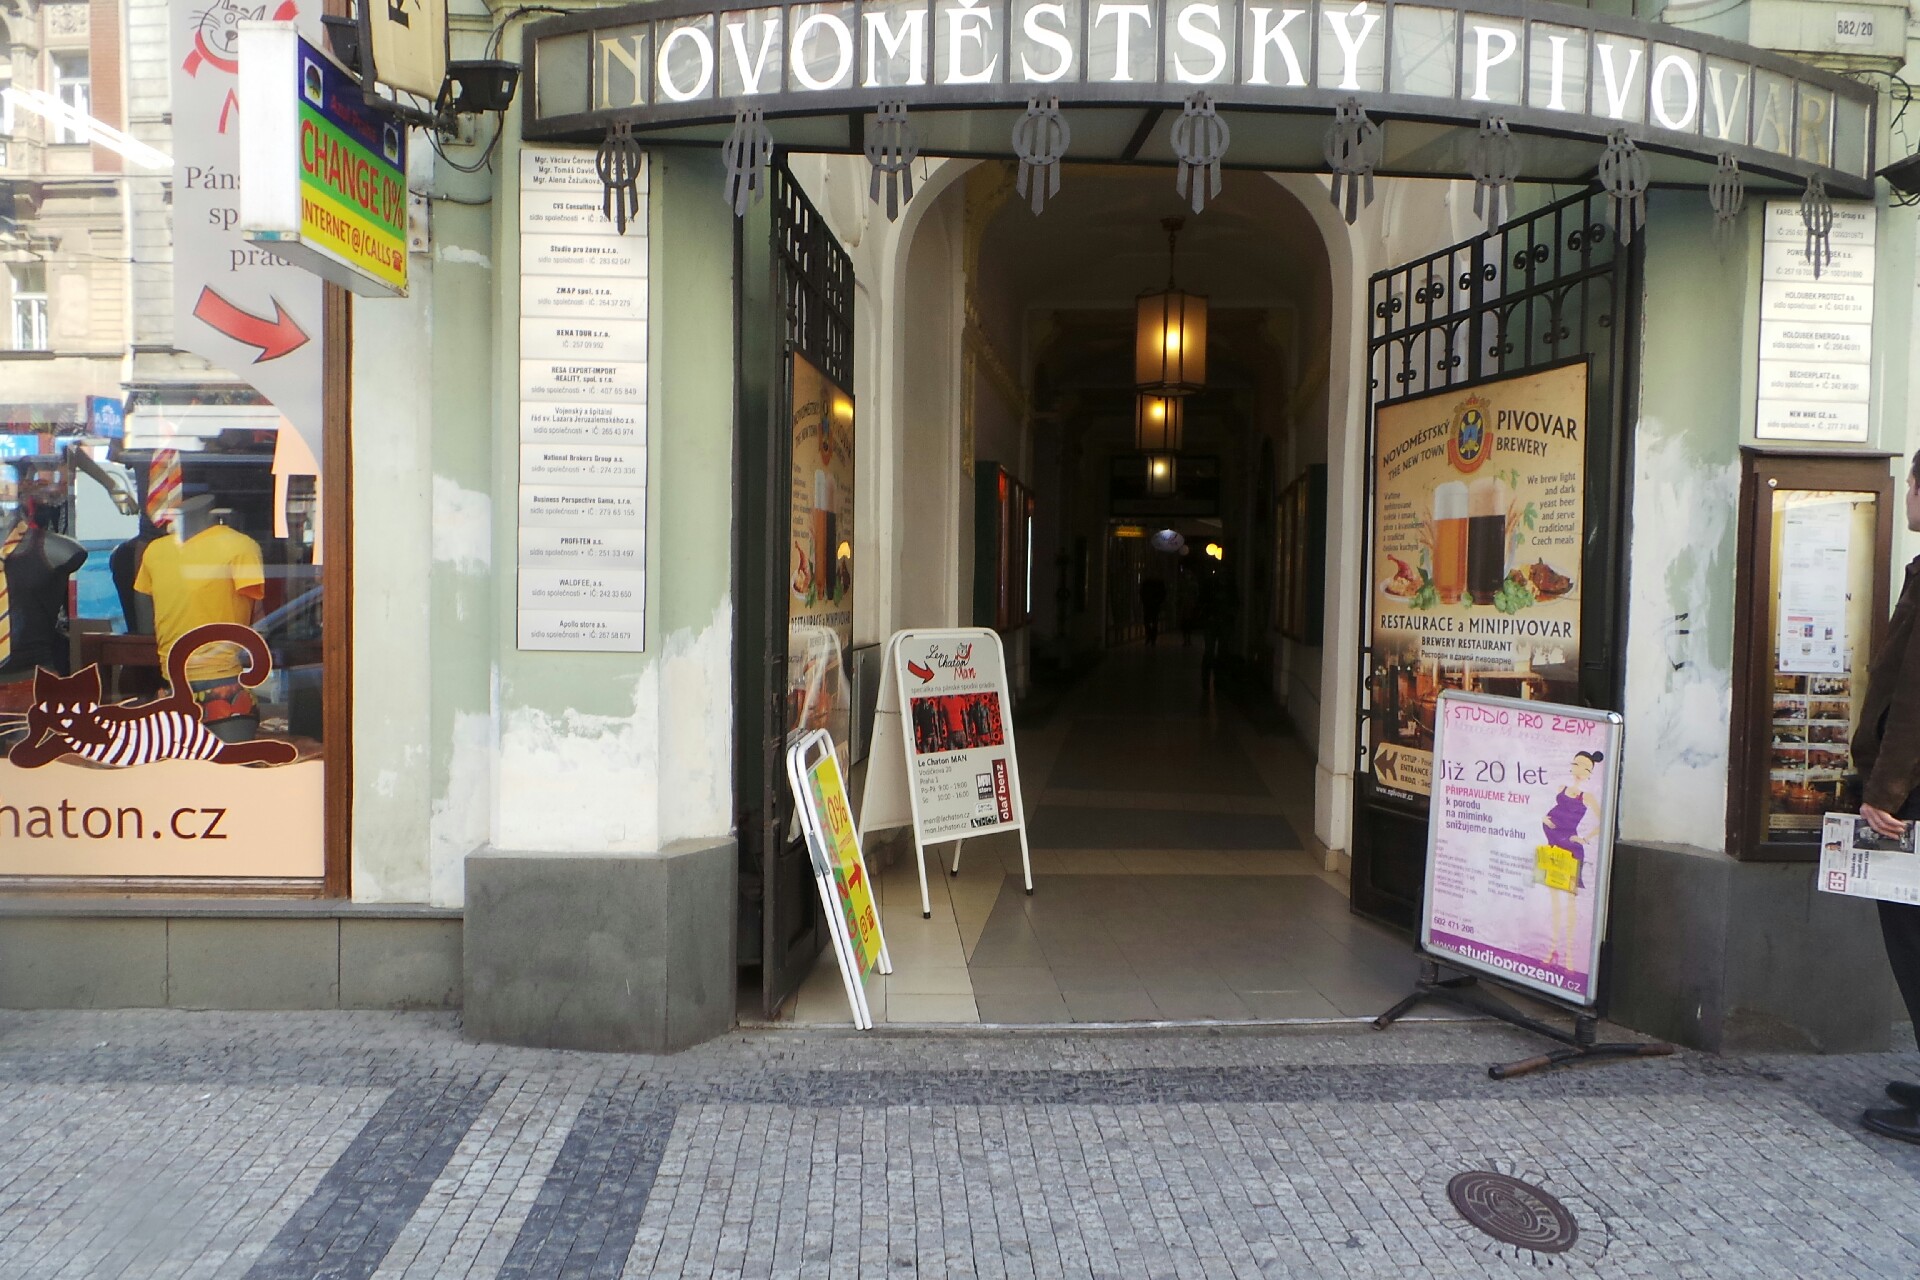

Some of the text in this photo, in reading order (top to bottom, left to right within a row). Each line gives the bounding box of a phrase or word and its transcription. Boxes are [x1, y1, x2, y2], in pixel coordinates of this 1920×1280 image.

[1837, 18, 1874, 39] 682/20
[599, 0, 1830, 166] NOVOMĚSTSKÝ PIVOVAR
[535, 156, 548, 164] Mgr.
[301, 119, 403, 230] CHANGE 0%
[539, 166, 552, 174] Mgr.
[533, 176, 548, 184] Mgr.
[302, 196, 391, 266] INTERNET@/CALLS
[1497, 410, 1577, 441] PIVOVAR
[1383, 419, 1450, 468] NOVOMĚSTSKÝ
[1496, 437, 1548, 457] BREWERY
[1388, 444, 1445, 481] THE NEW TOWN
[1527, 472, 1576, 484] We brew light
[1545, 484, 1575, 496] and dark
[561, 496, 596, 504] Perspective
[1540, 499, 1575, 510] yeast beer
[1542, 511, 1554, 520] and
[1539, 523, 1575, 533] traditional
[1531, 536, 1574, 546] Czech meals
[1381, 614, 1572, 638] RESTAURACE a MINIPIVOVAR
[1422, 637, 1513, 652] BREWERY RESTAURANT
[954, 667, 976, 680] Man
[1455, 706, 1595, 736] STUDIO PRO ŽENY
[927, 758, 949, 766] Chaton
[1401, 754, 1417, 763] VSTUP
[1400, 764, 1428, 775] ENTRANCE
[1440, 759, 1549, 785] Již 20 let
[997, 764, 1009, 819] olaf benz
[1446, 784, 1530, 805] PŘIPRAVUJEME ŽENY
[1446, 797, 1481, 810] k porodu
[827, 790, 848, 836] 0%
[1446, 810, 1493, 823] na miminko
[1446, 820, 1526, 840] snižujeme nadváhu
[1434, 916, 1445, 926] 602
[1448, 920, 1459, 930] 471
[1433, 940, 1581, 992] wwwstudioprozeny.cz
